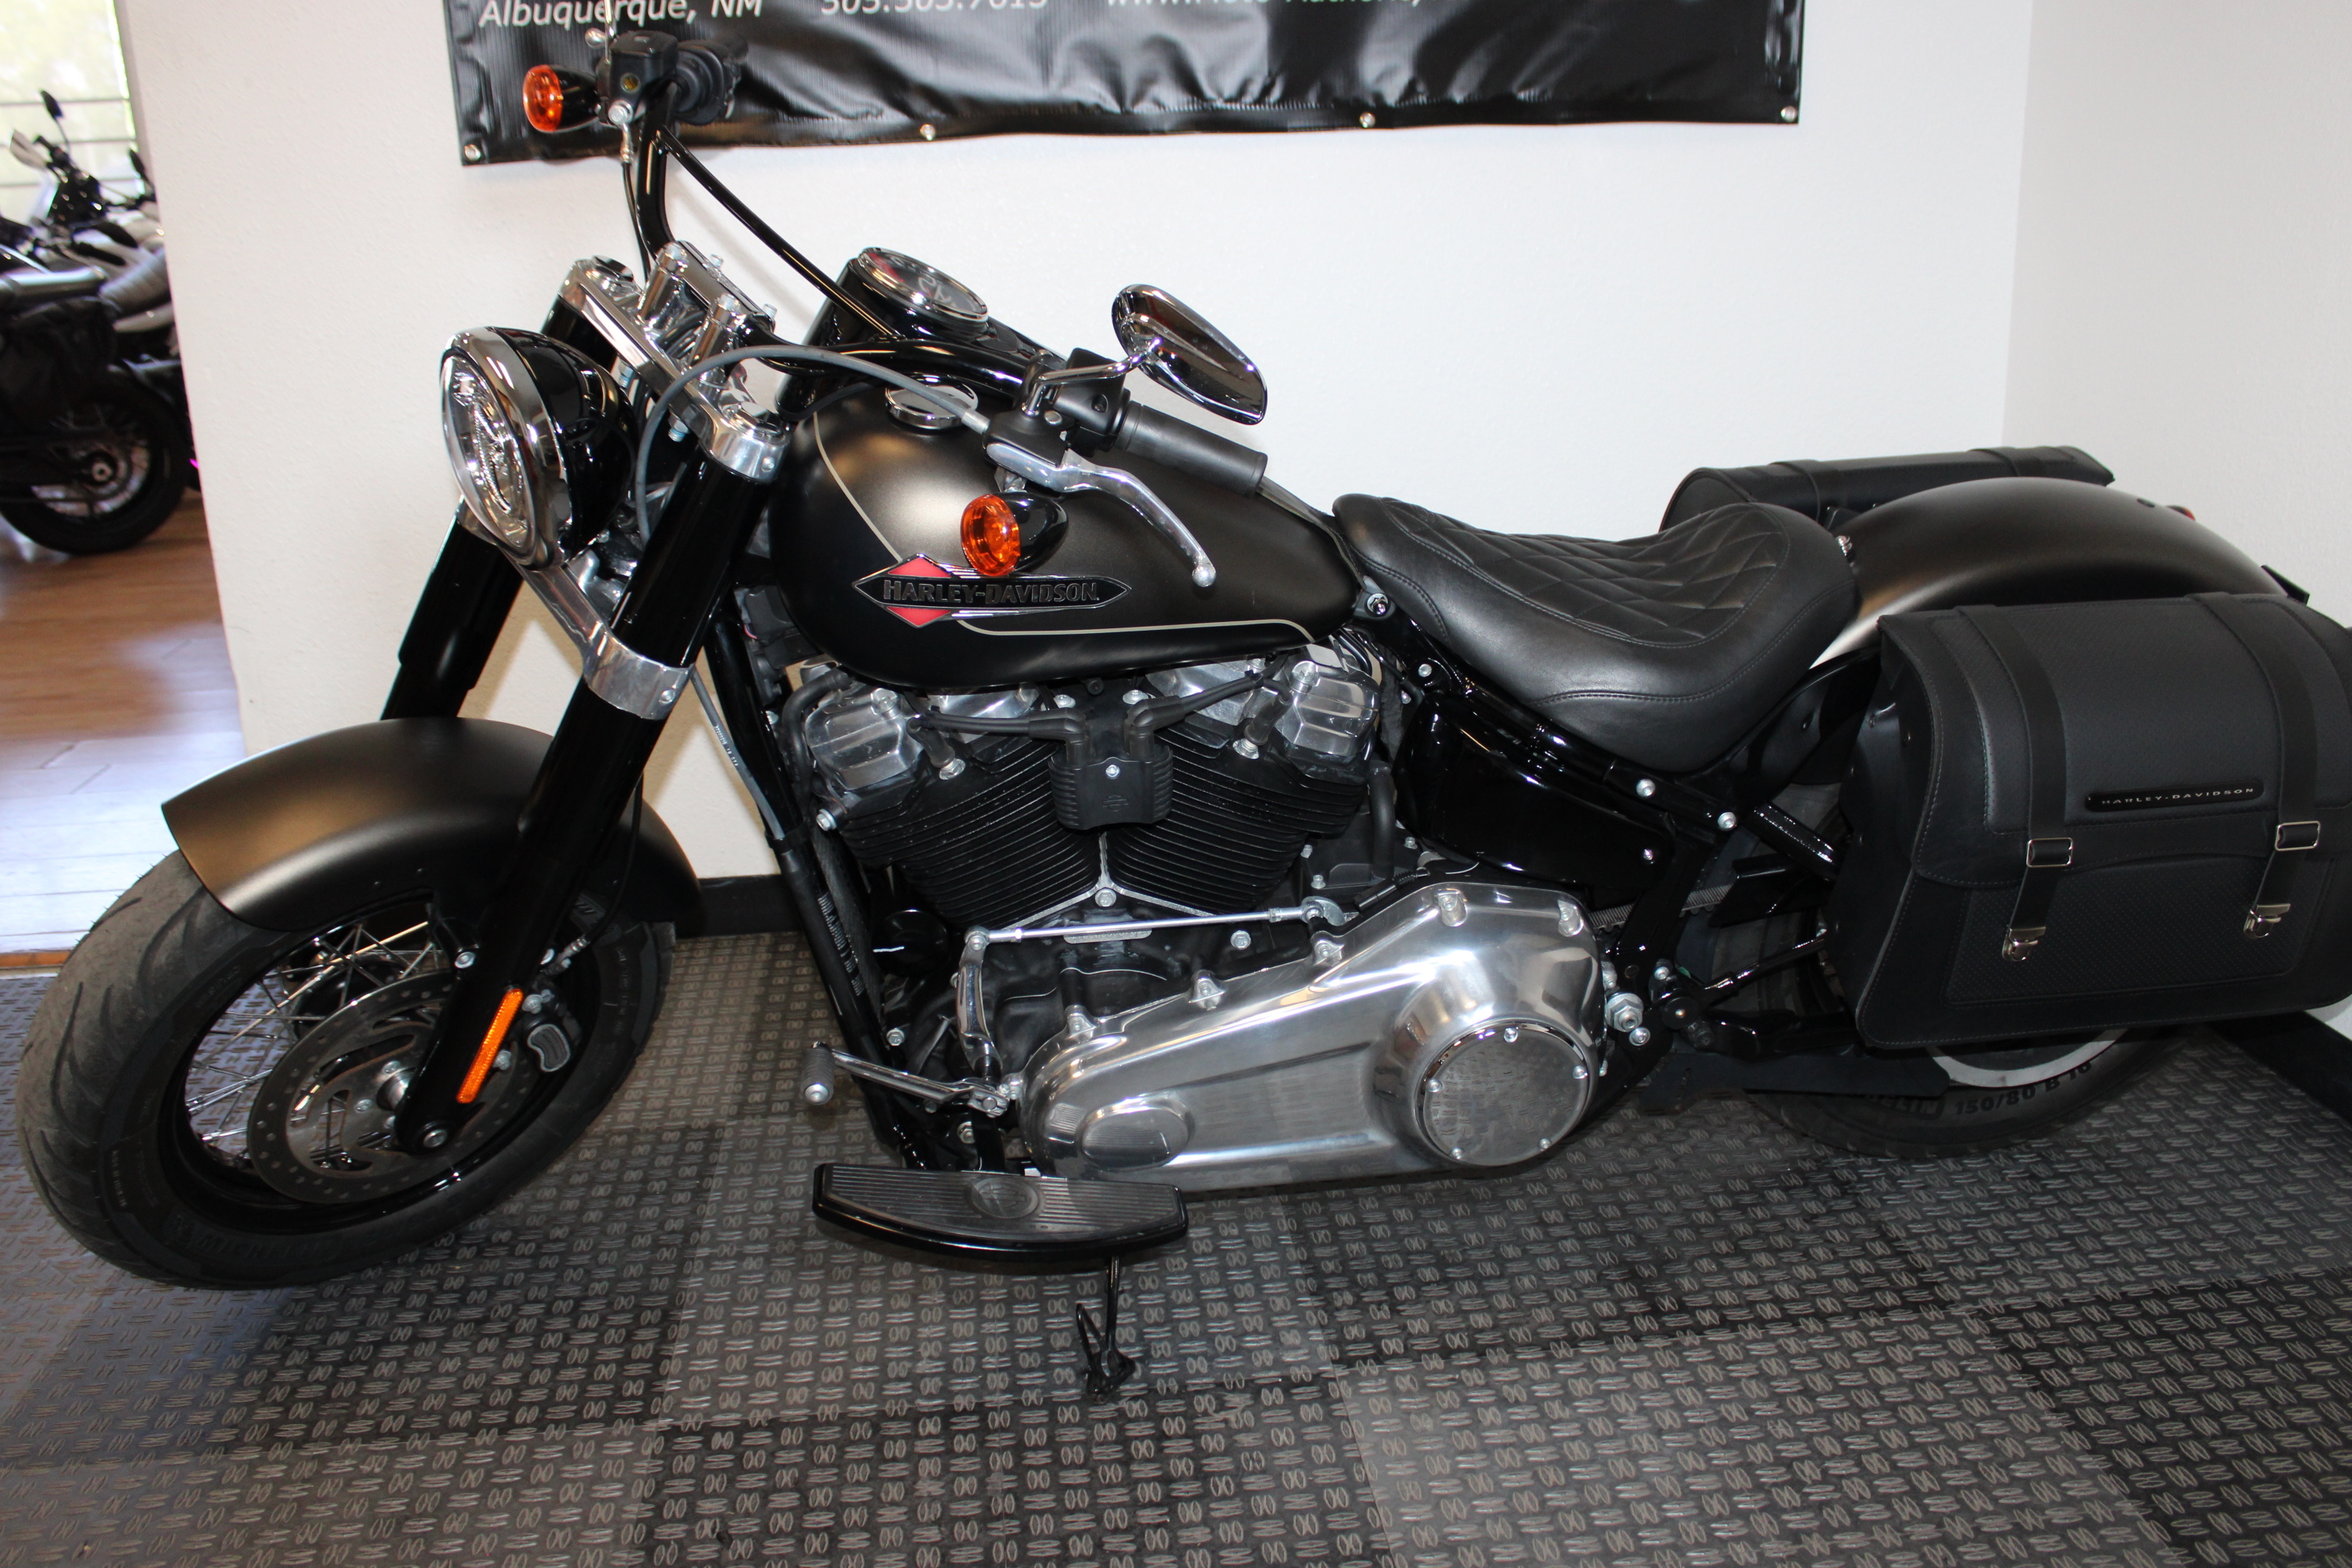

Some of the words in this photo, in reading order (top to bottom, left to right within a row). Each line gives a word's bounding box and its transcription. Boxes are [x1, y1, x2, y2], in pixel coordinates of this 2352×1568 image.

[478, 0, 696, 30] Albuquerque,
[711, 0, 762, 17] NM
[883, 579, 1098, 605] HARLEY-DAVIDSON
[2101, 788, 2254, 805] HARLEY-DAVIDSON
